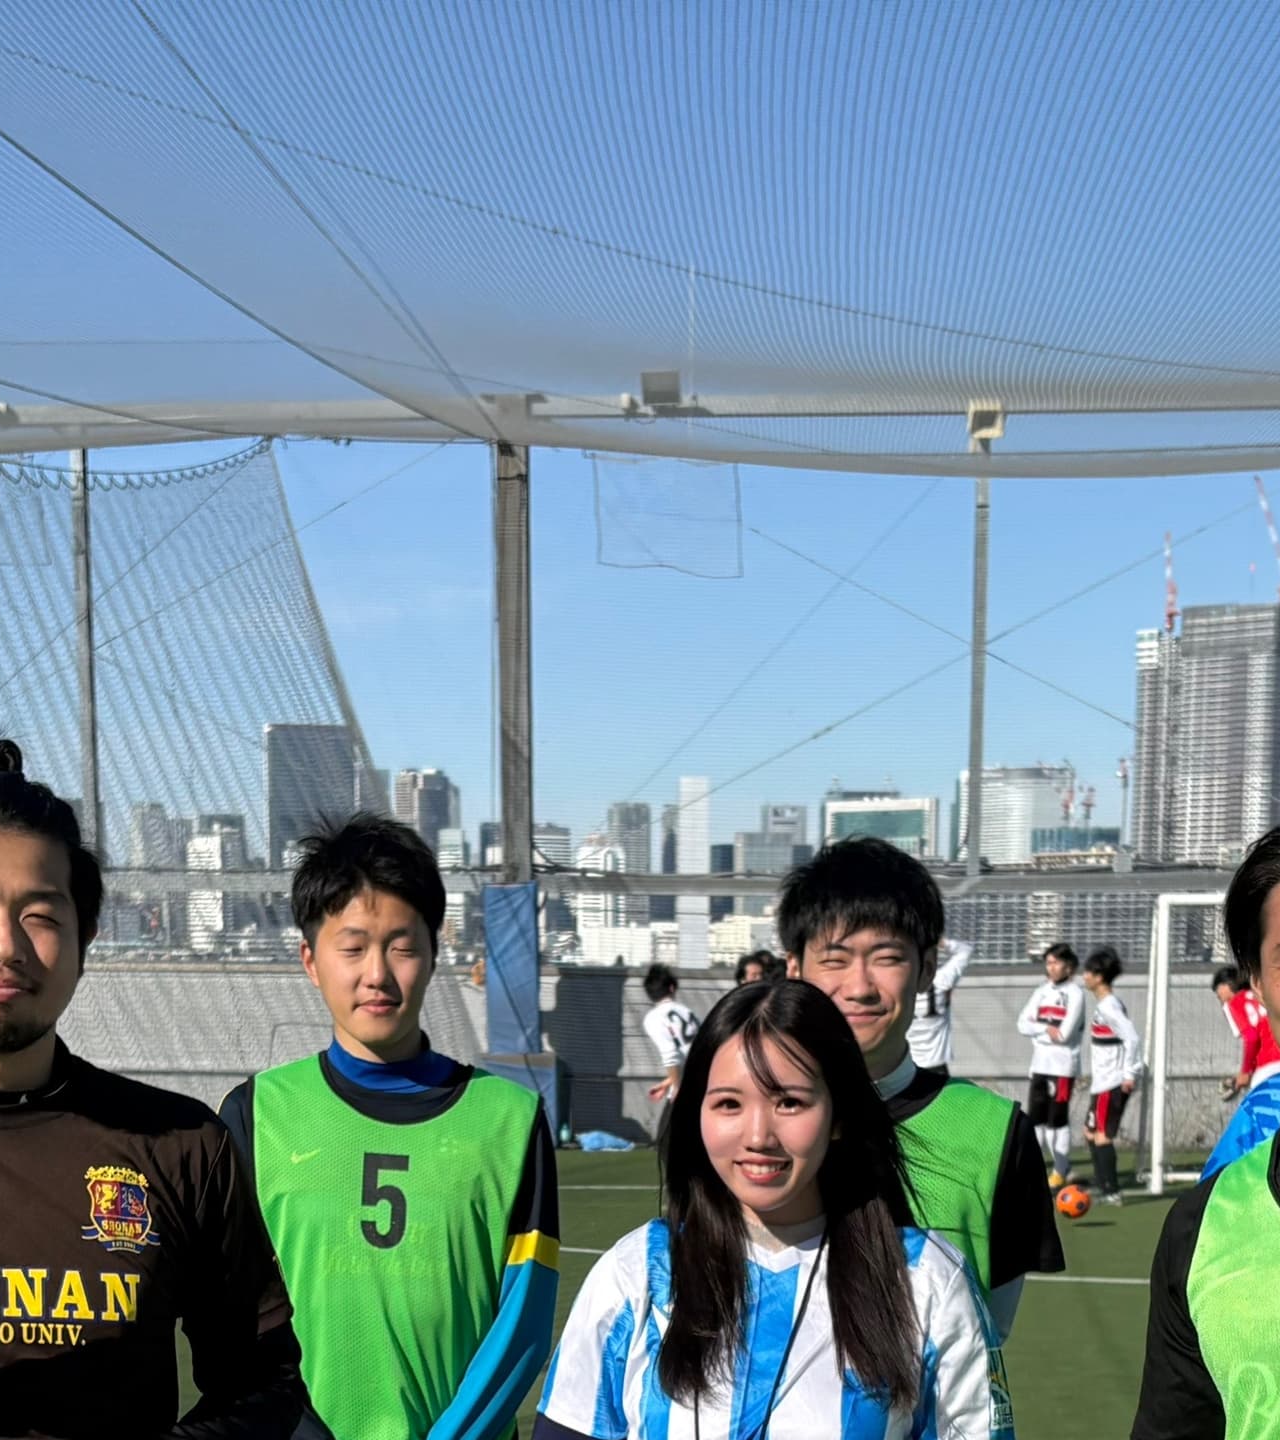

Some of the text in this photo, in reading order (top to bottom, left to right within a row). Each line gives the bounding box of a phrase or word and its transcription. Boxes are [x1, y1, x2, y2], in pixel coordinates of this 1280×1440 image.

[360, 1152, 410, 1249] 5
[101, 1220, 143, 1238] SHONAN
[22, 1323, 87, 1347] UNIV.
